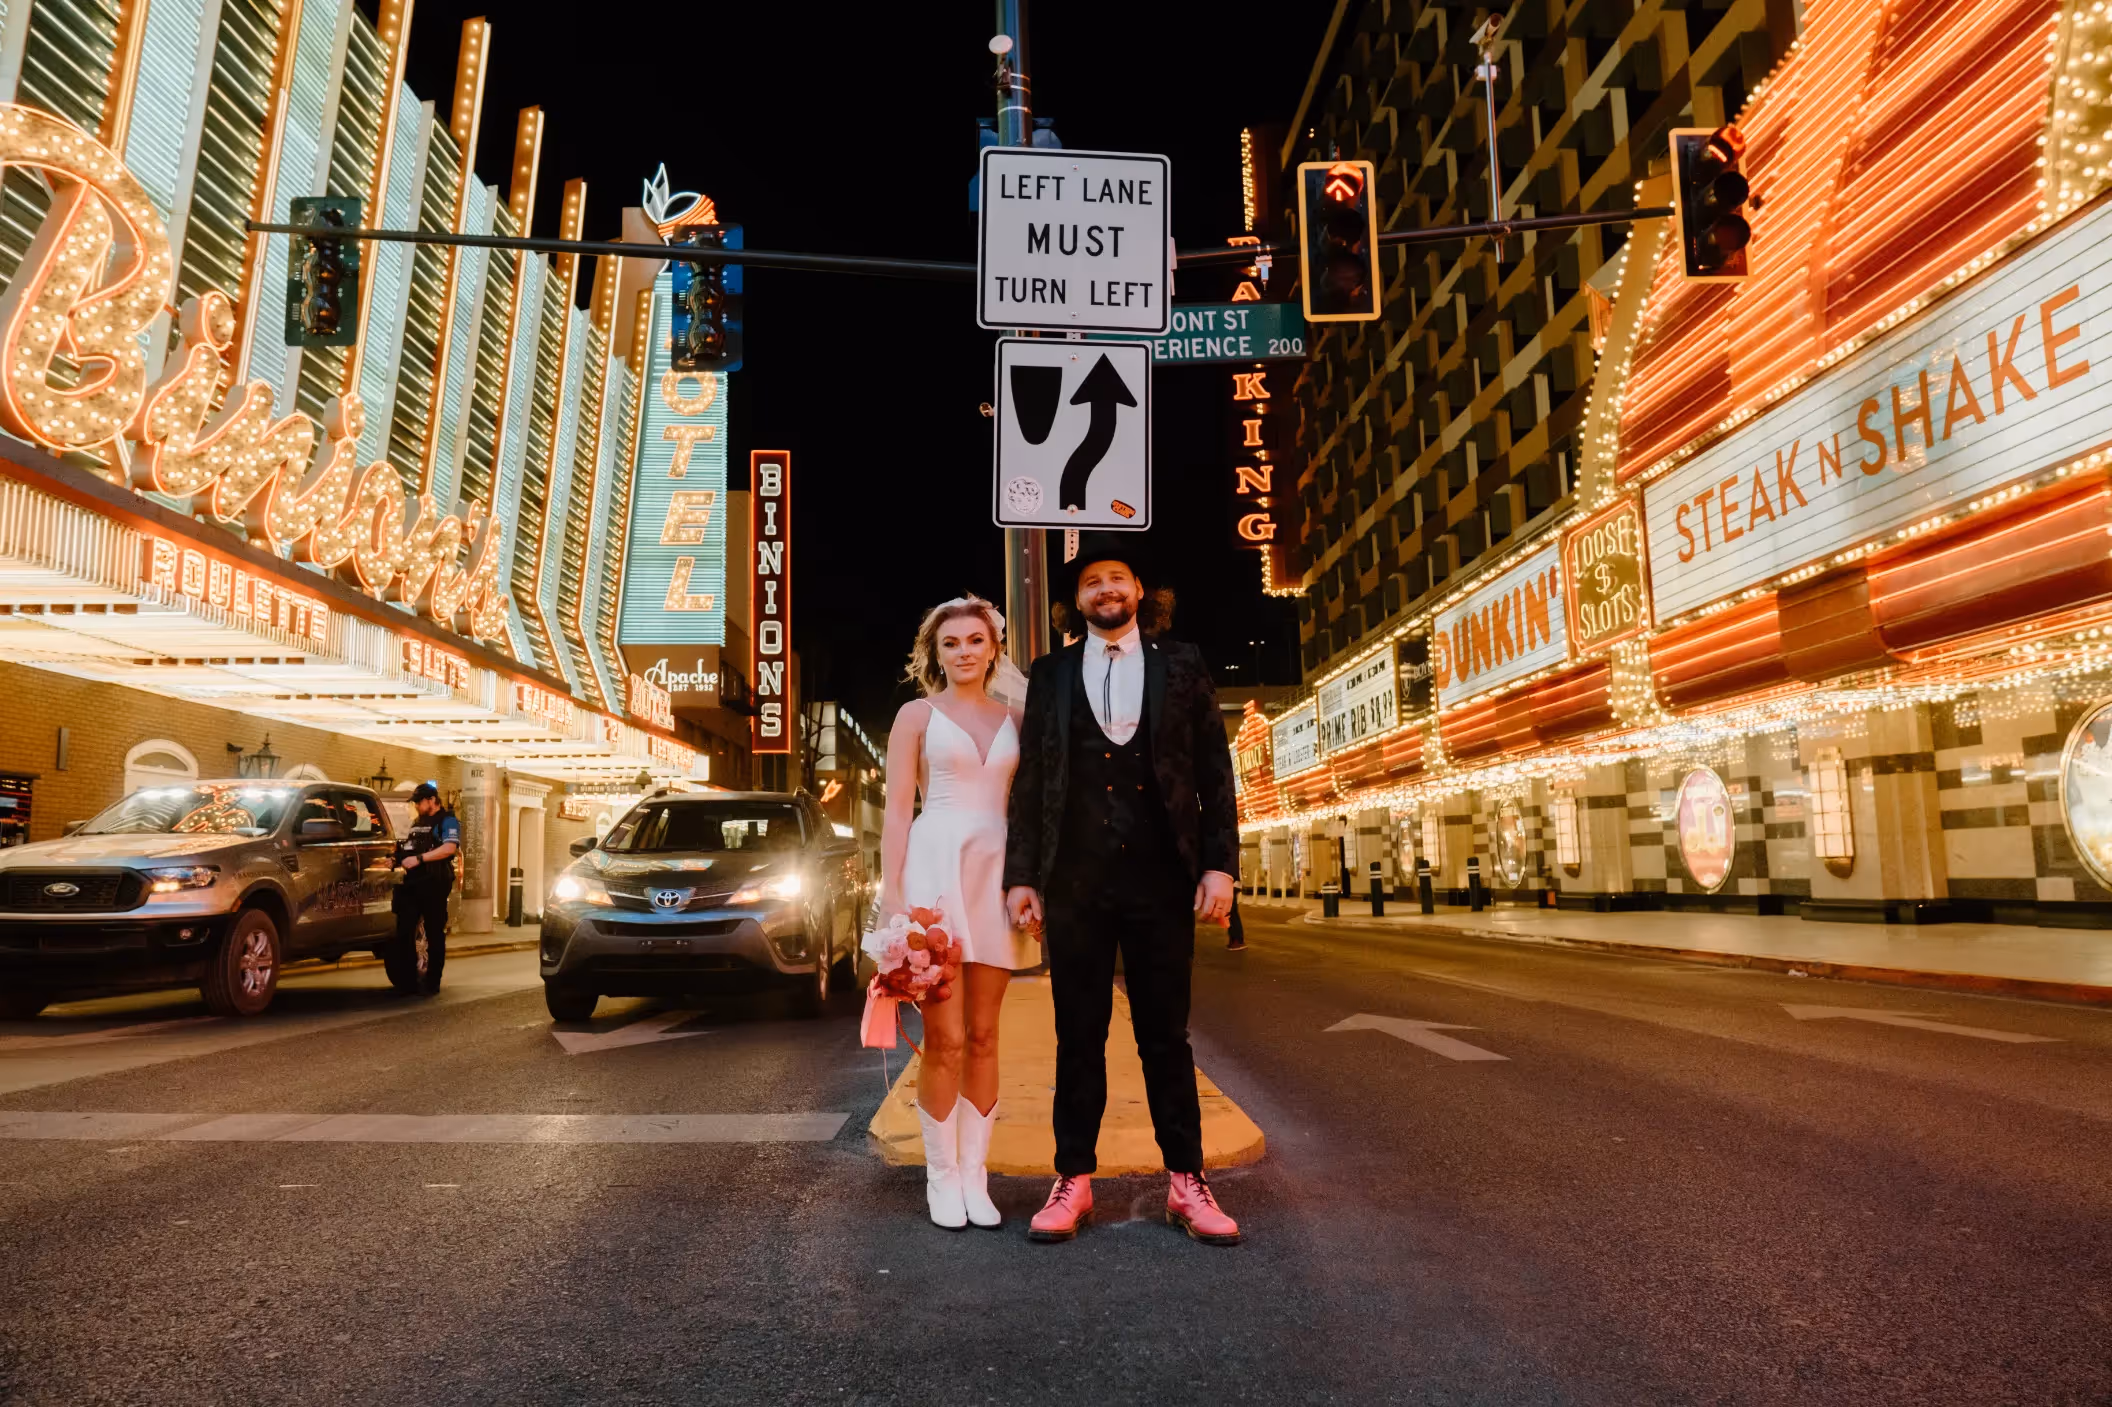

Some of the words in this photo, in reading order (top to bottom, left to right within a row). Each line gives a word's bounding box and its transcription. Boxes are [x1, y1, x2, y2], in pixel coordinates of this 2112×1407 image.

[1001, 174, 1065, 201] LEFT
[1083, 178, 1153, 206] LANE
[1027, 223, 1125, 258] MUST
[995, 276, 1066, 304] TURN
[1090, 280, 1153, 308] LEFT
[1172, 311, 1216, 332] ONT
[1223, 310, 1249, 331] ST
[0, 103, 510, 641] Binion's
[1152, 336, 1253, 360] ERIENCE
[1268, 338, 1303, 355] 200
[1675, 440, 1808, 563] STEAK
[1817, 434, 1843, 487] N
[1856, 284, 2091, 477] SHAKE
[660, 322, 718, 612] OTEL
[1573, 515, 1636, 579] LOOSE
[151, 535, 330, 645] ROULETTE
[759, 463, 784, 739] BINIONS
[1580, 584, 1634, 639] SLOTS
[1435, 565, 1558, 690] DUNKIN'
[408, 639, 471, 690] SLOTS
[644, 657, 719, 693] Apache
[1321, 712, 1346, 750] PRIME
[1351, 703, 1367, 739] RIB
